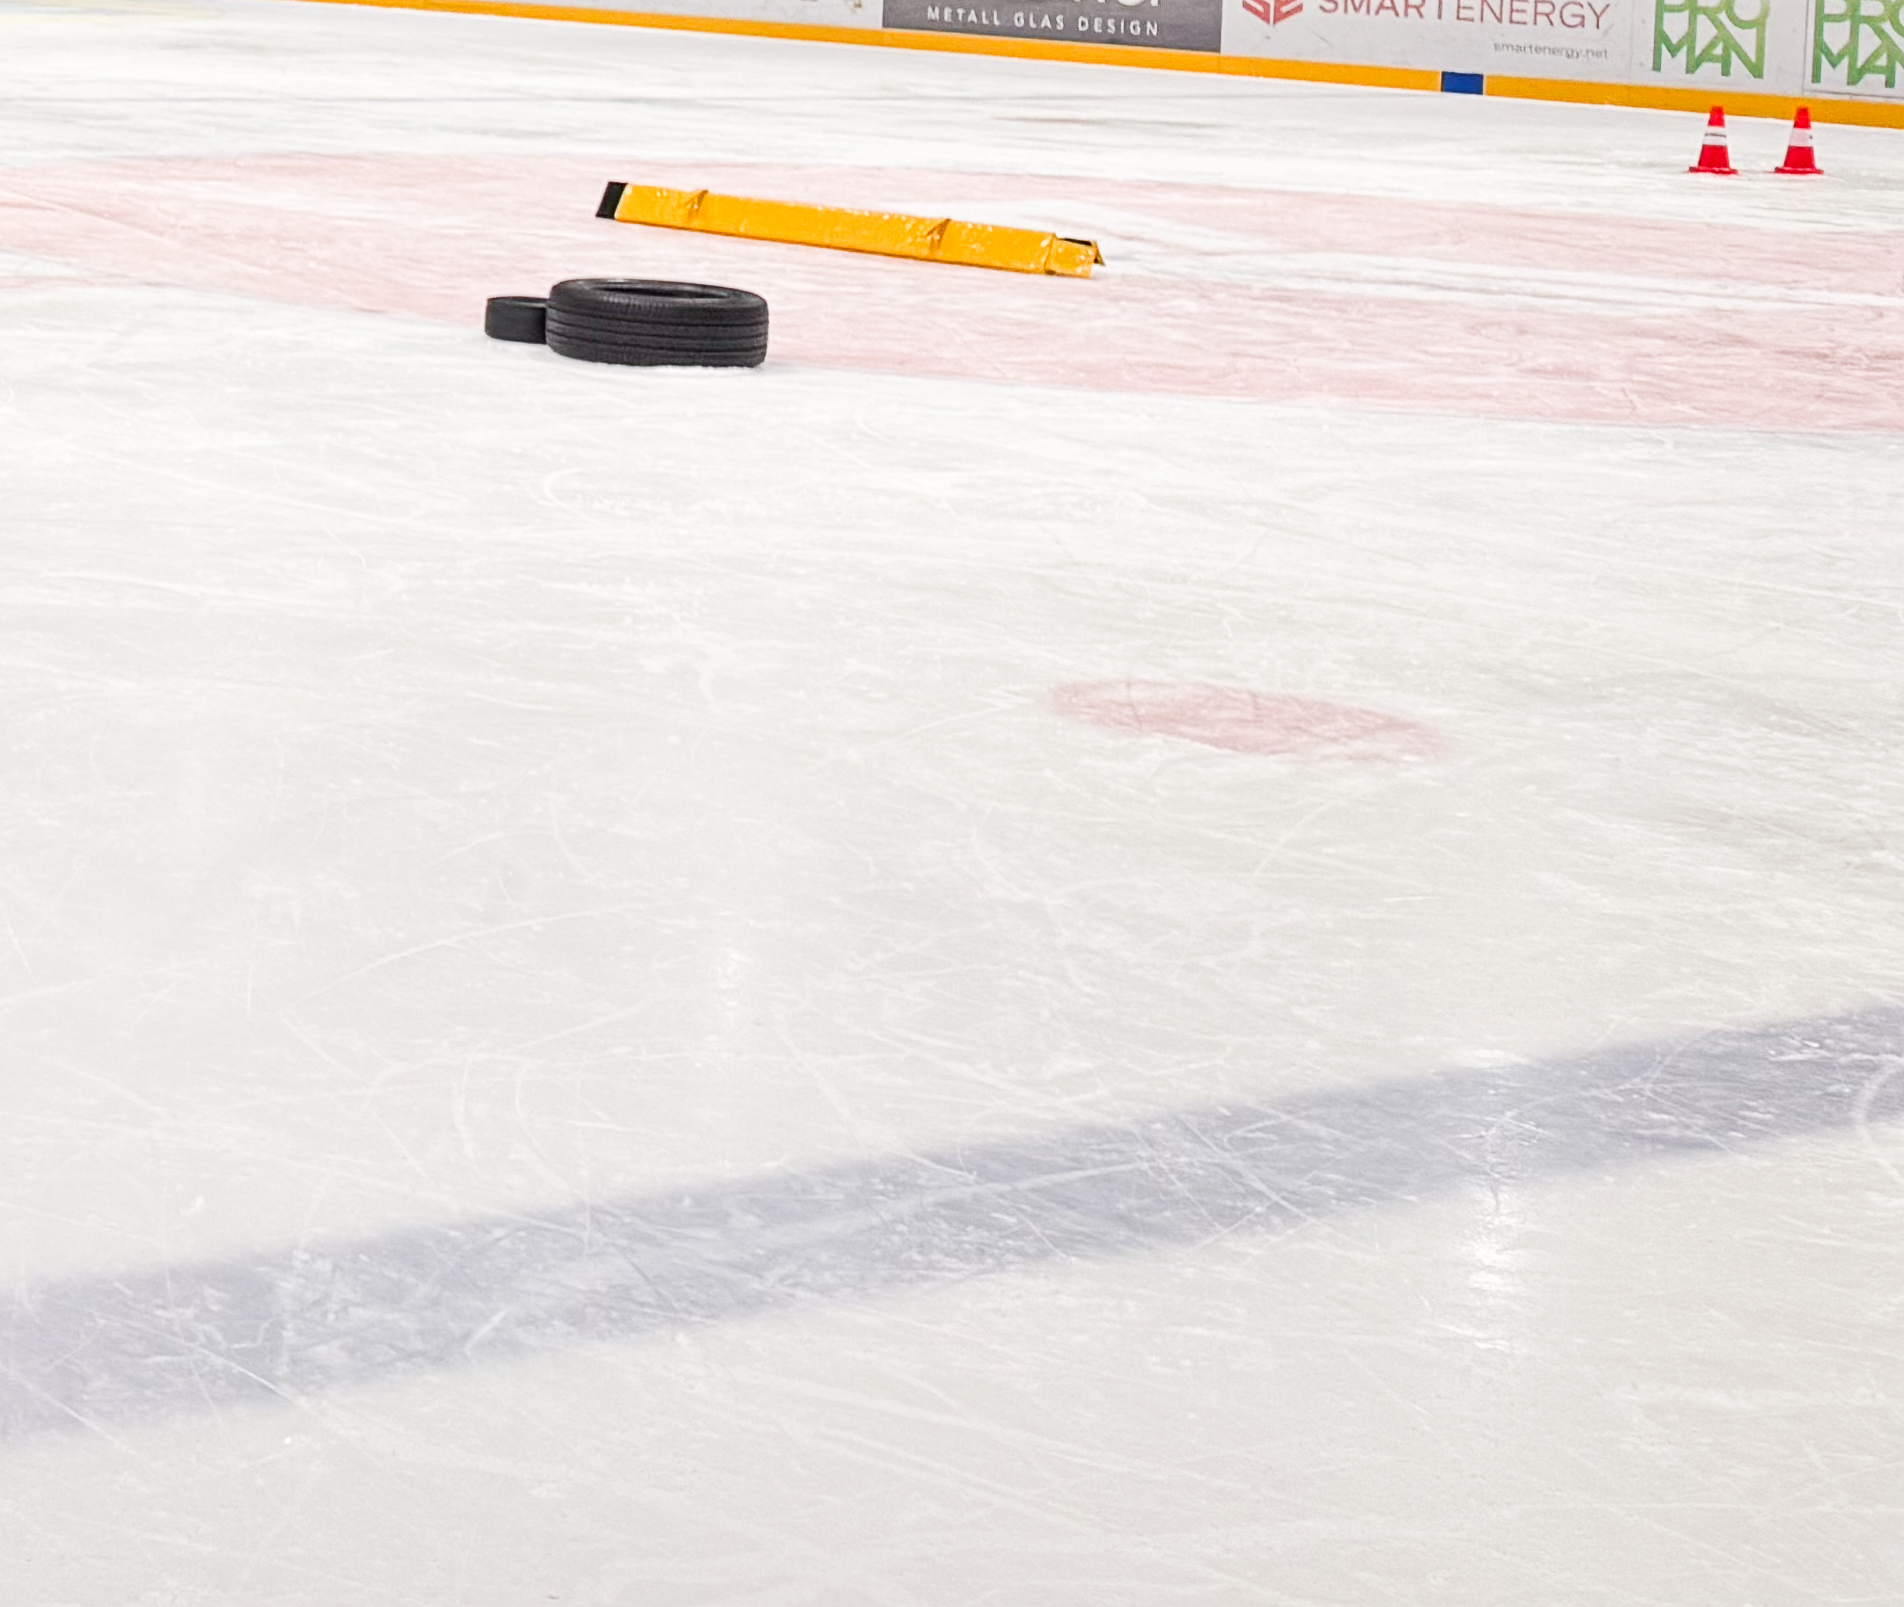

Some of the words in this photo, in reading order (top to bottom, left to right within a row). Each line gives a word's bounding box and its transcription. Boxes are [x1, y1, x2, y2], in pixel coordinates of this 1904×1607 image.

[928, 5, 1000, 26] METALL
[1014, 11, 1065, 31] GLAS
[1078, 16, 1159, 36] DESIGN
